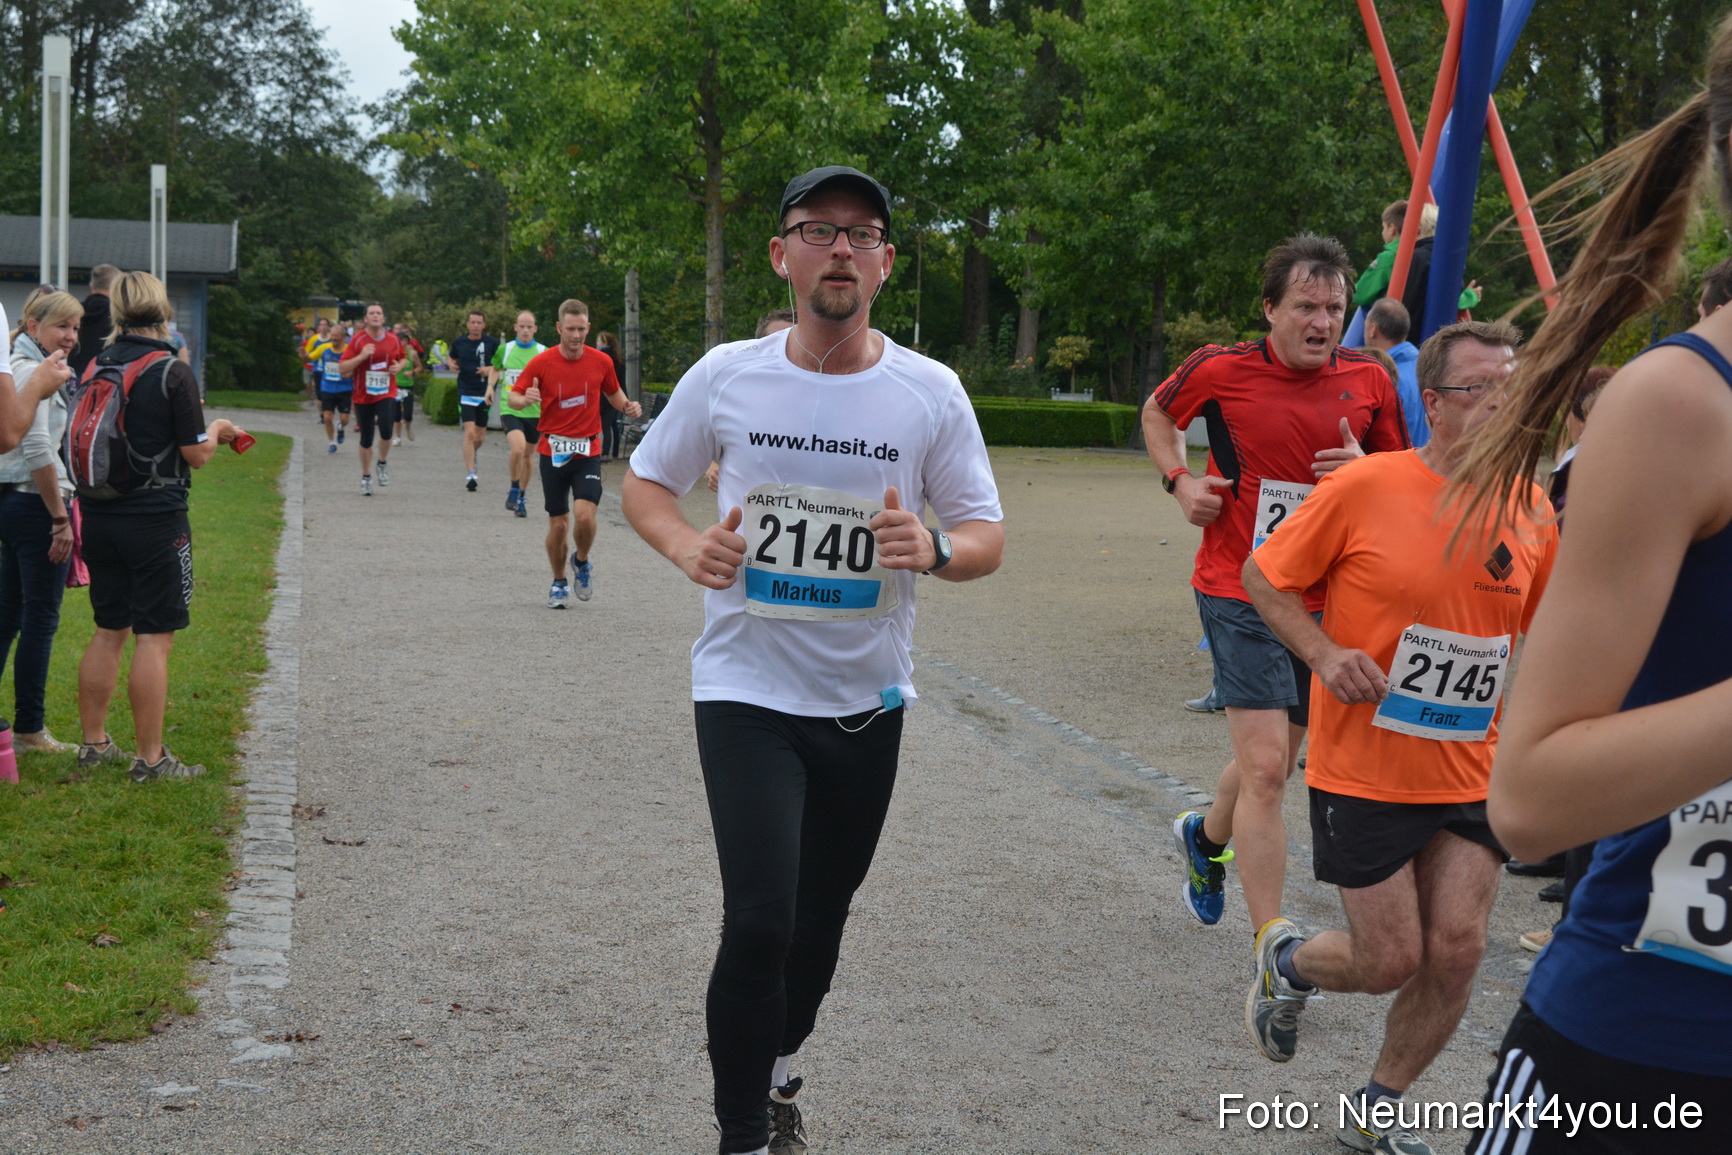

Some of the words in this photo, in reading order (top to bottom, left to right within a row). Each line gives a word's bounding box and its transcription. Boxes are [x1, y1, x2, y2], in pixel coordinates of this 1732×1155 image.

[748, 431, 900, 462] www.hasit.de
[747, 493, 793, 509] PARTL
[797, 498, 866, 520] Neumarkt
[1262, 487, 1295, 501] PARTL
[755, 513, 876, 573] 2140
[771, 579, 843, 604] Markus
[1403, 632, 1445, 652] PARTL
[1448, 643, 1498, 659] Neumarkt
[1399, 652, 1499, 703] 2145
[1419, 706, 1462, 726] Franz
